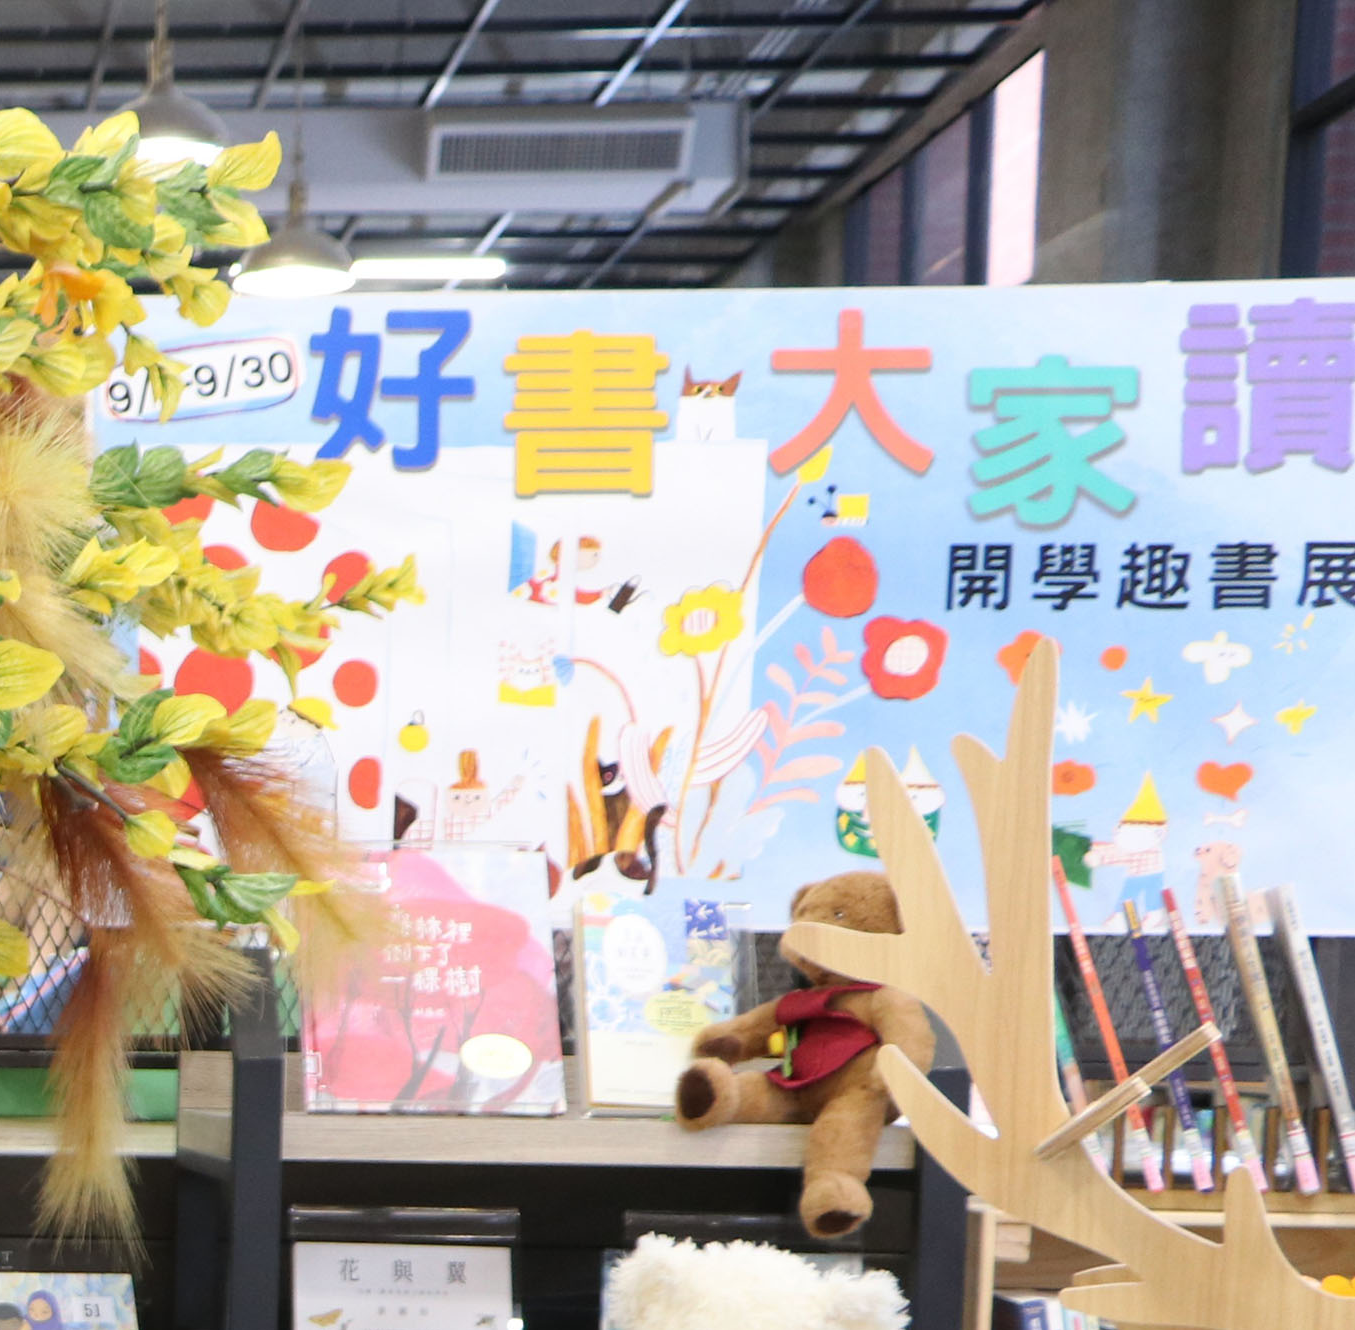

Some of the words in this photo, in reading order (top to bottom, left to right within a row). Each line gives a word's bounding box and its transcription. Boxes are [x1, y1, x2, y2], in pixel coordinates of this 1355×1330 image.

[946, 541, 1355, 611] 開學趣書展
